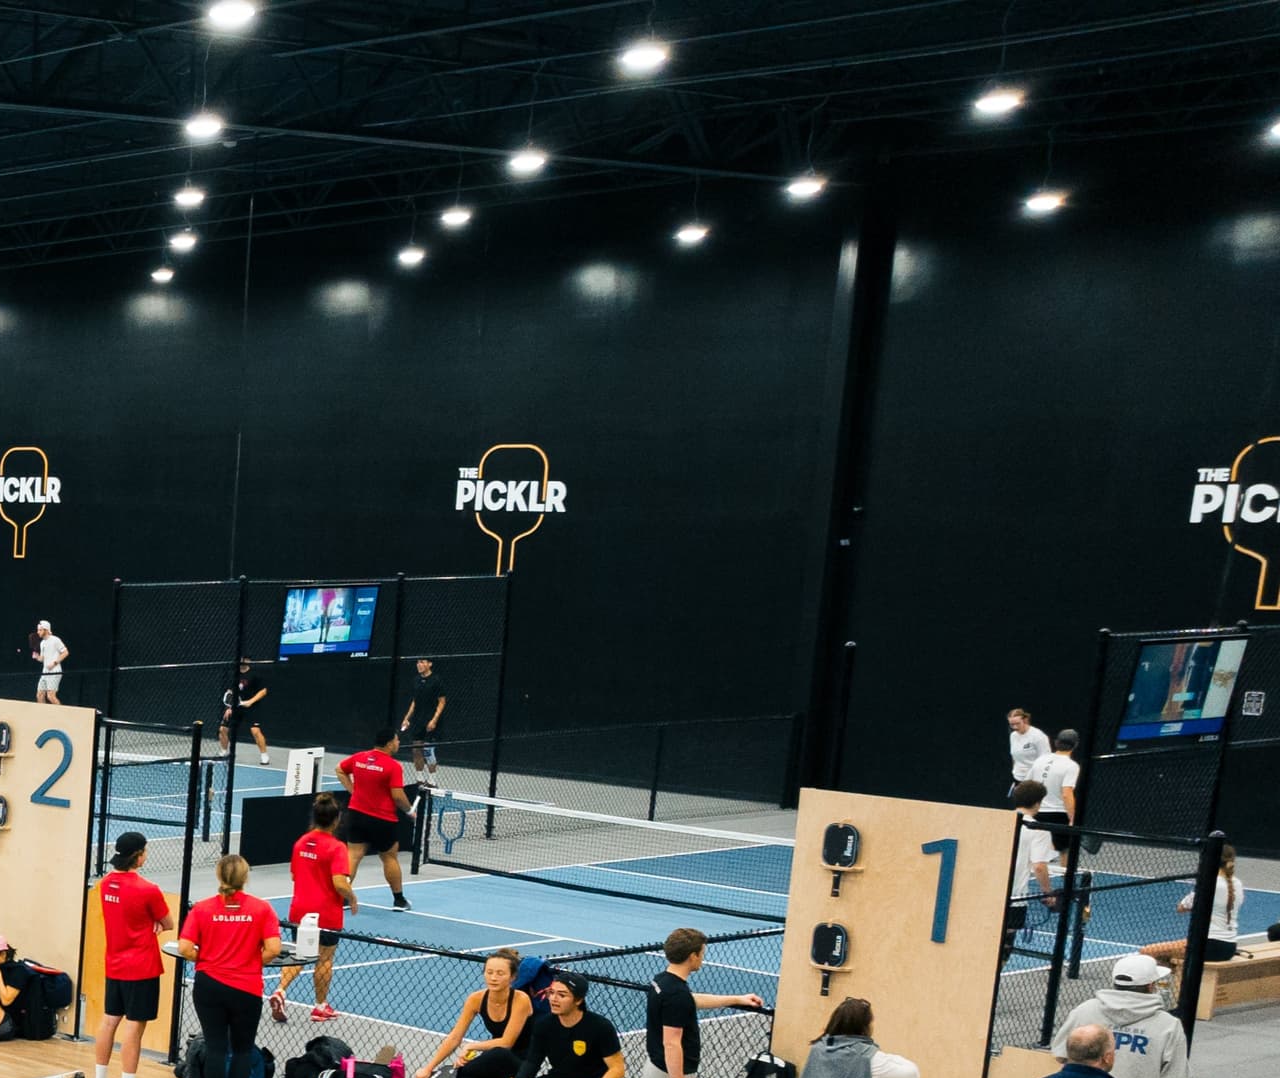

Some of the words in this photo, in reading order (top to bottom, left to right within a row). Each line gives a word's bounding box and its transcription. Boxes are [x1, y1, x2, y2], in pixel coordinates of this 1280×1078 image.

[458, 467, 479, 479] THE
[1197, 468, 1231, 482] THE
[455, 480, 567, 513] PICKLR
[1189, 483, 1280, 523] PIC
[30, 729, 73, 808] 2
[921, 838, 959, 944] 1
